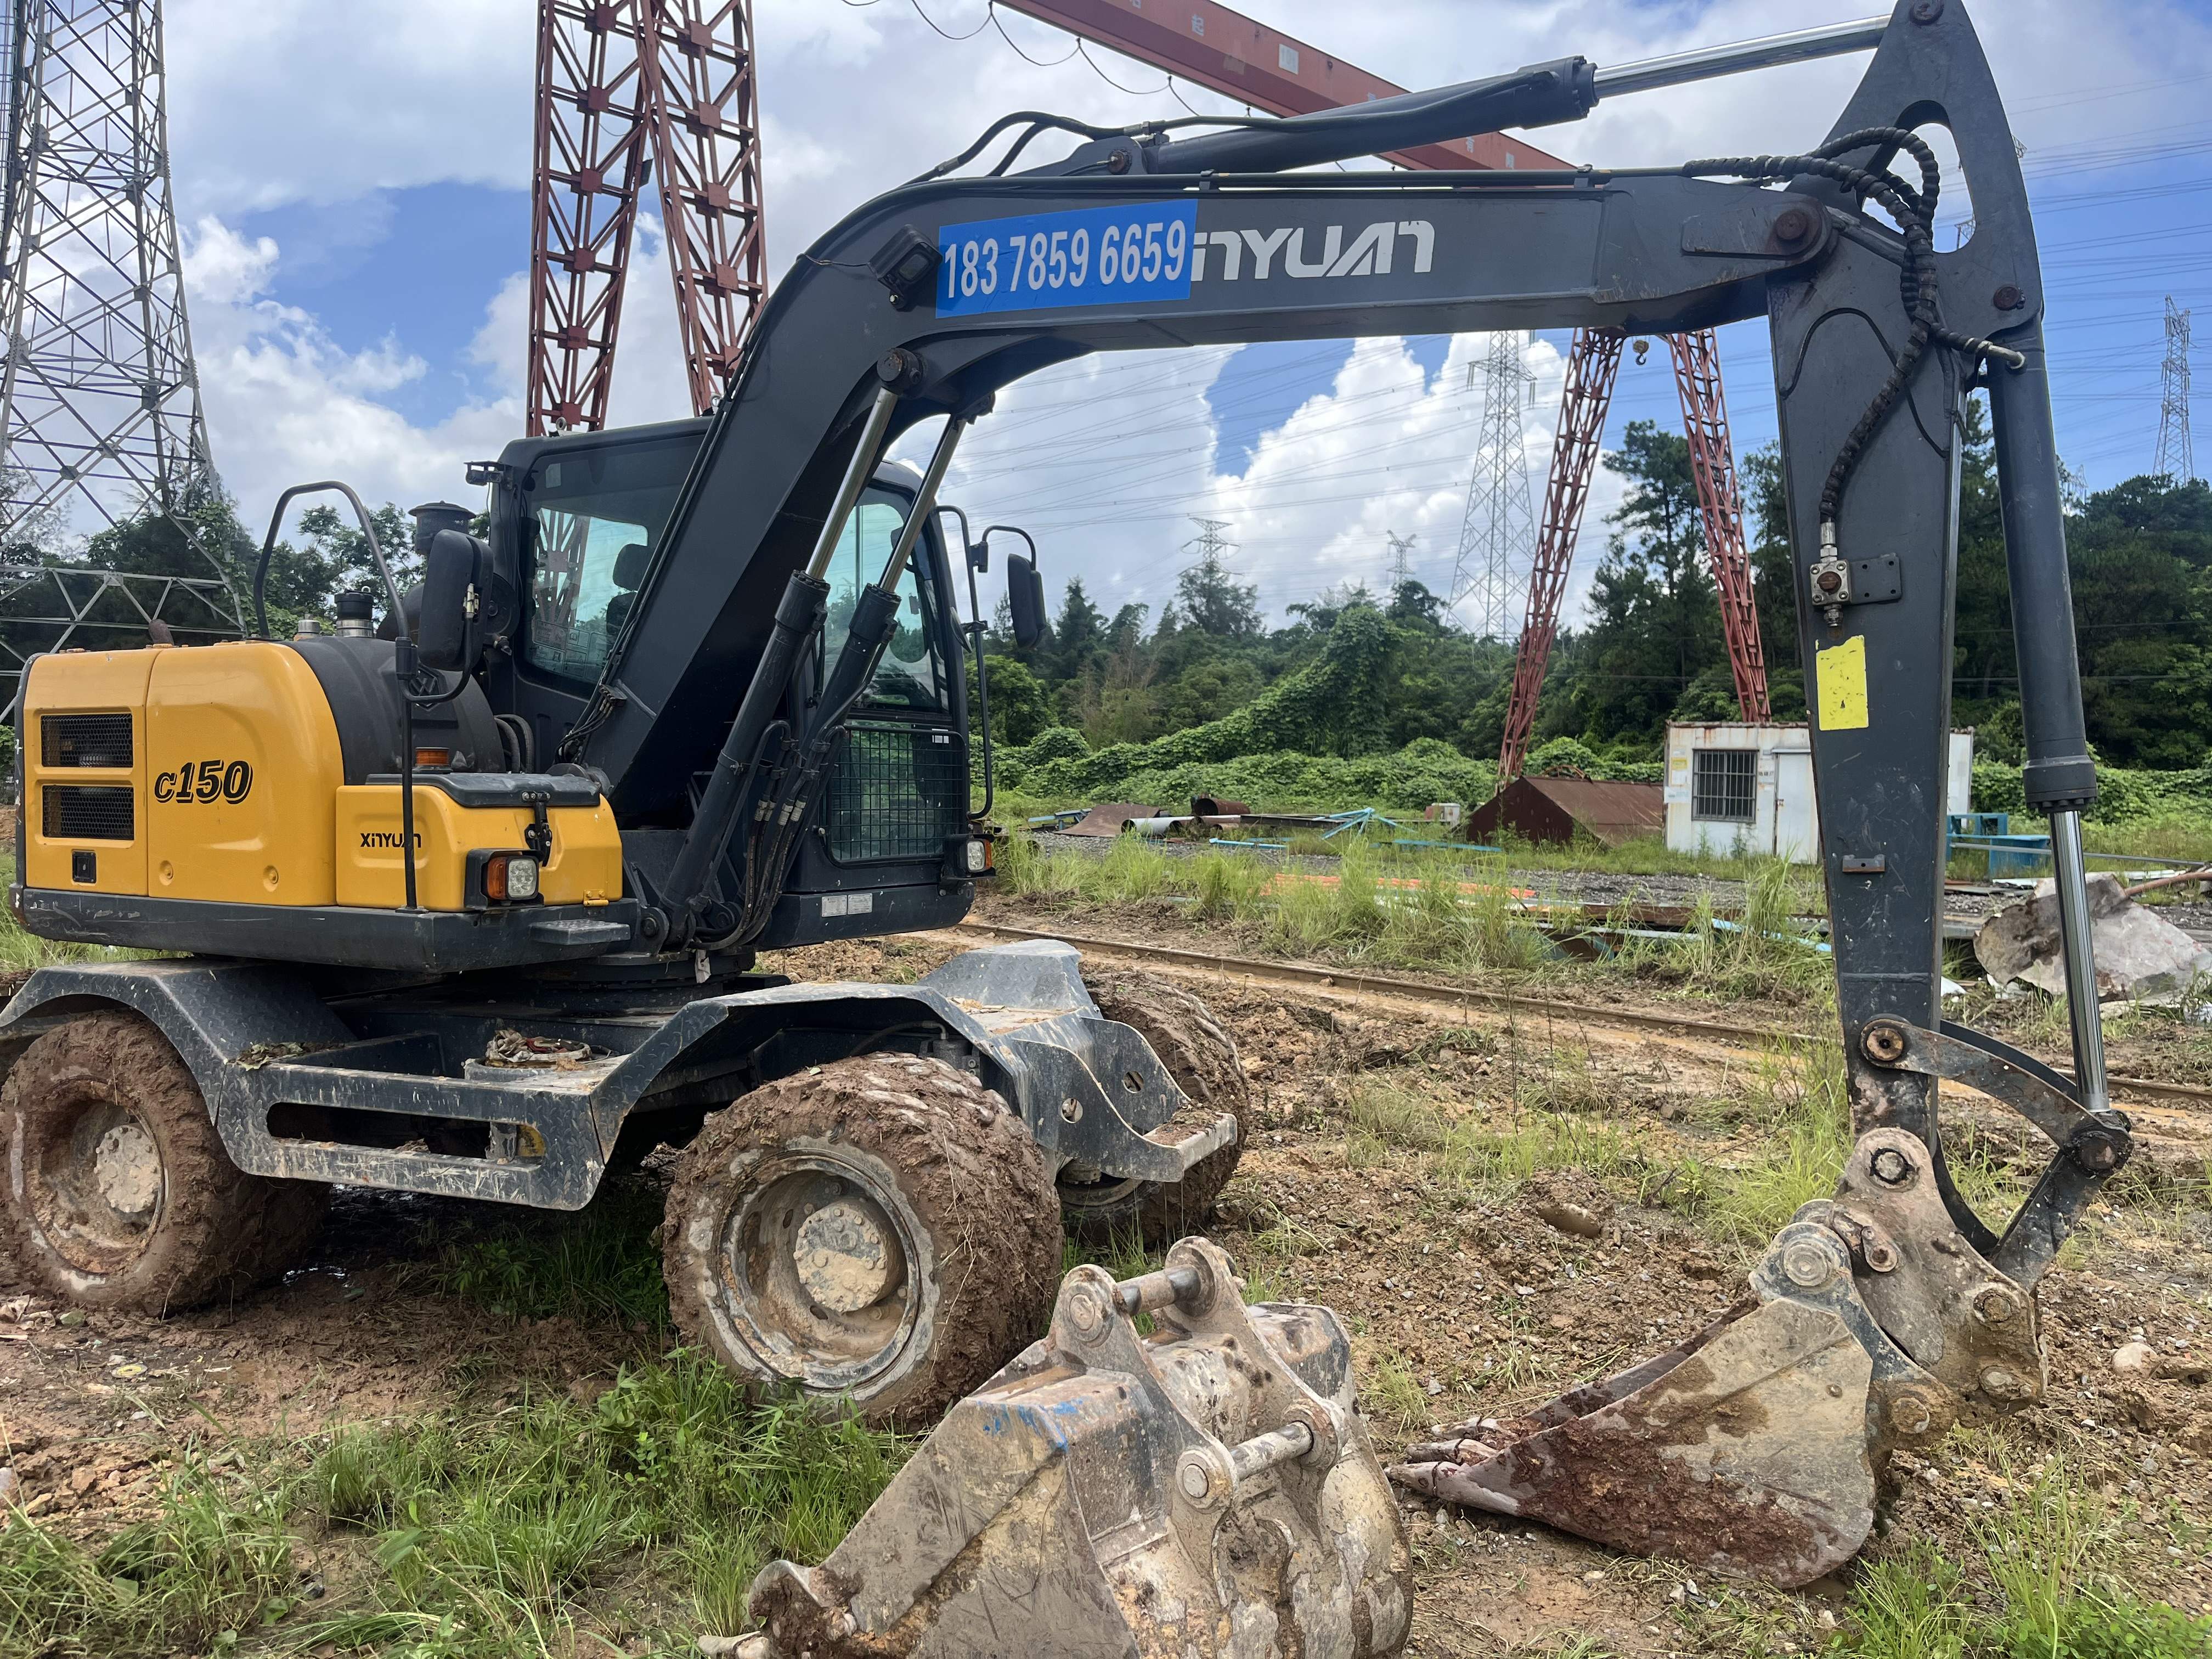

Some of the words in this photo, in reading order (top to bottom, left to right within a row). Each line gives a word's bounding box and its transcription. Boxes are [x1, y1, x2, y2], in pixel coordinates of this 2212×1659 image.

[945, 238, 998, 298] 183
[1009, 228, 1089, 291] 7859
[1099, 220, 1186, 285] 6659
